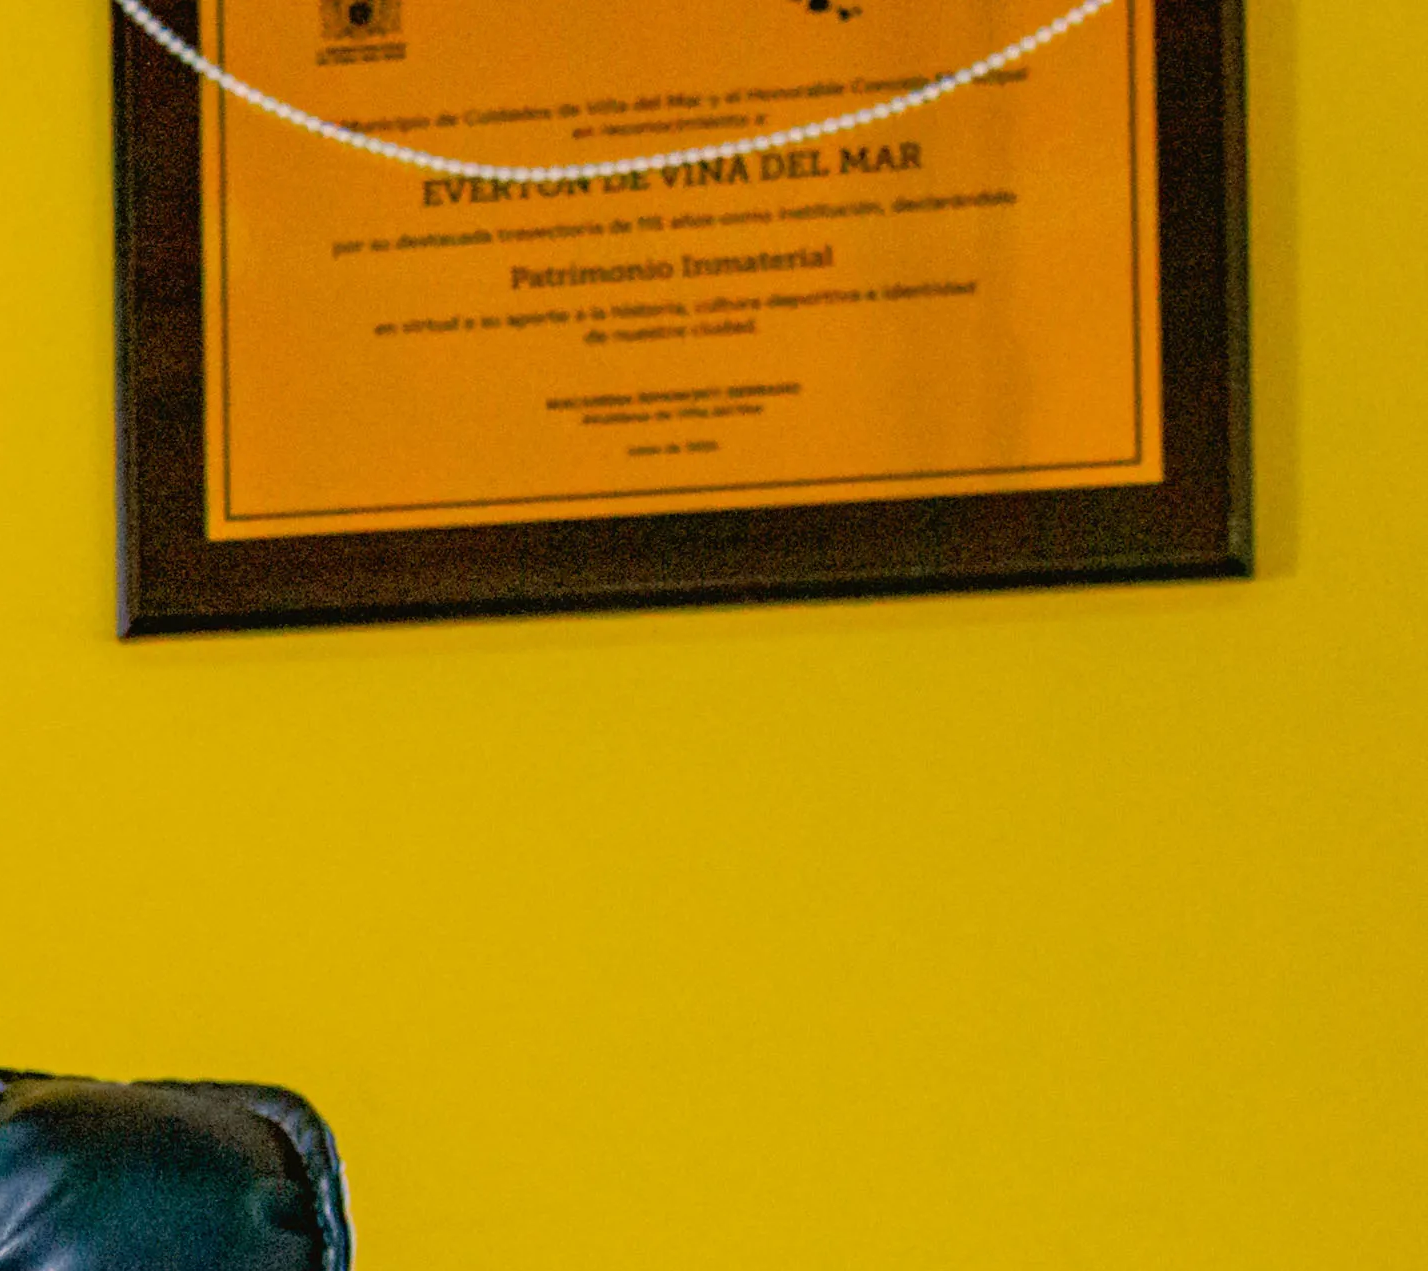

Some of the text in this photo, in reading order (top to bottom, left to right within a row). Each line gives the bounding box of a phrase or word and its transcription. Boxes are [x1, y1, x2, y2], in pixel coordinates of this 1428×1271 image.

[423, 174, 592, 207] EVERTON
[602, 168, 652, 195] DE
[759, 149, 831, 181] DEL
[838, 141, 924, 175] MAR
[511, 244, 834, 290] Patrimonio Inmaterial
